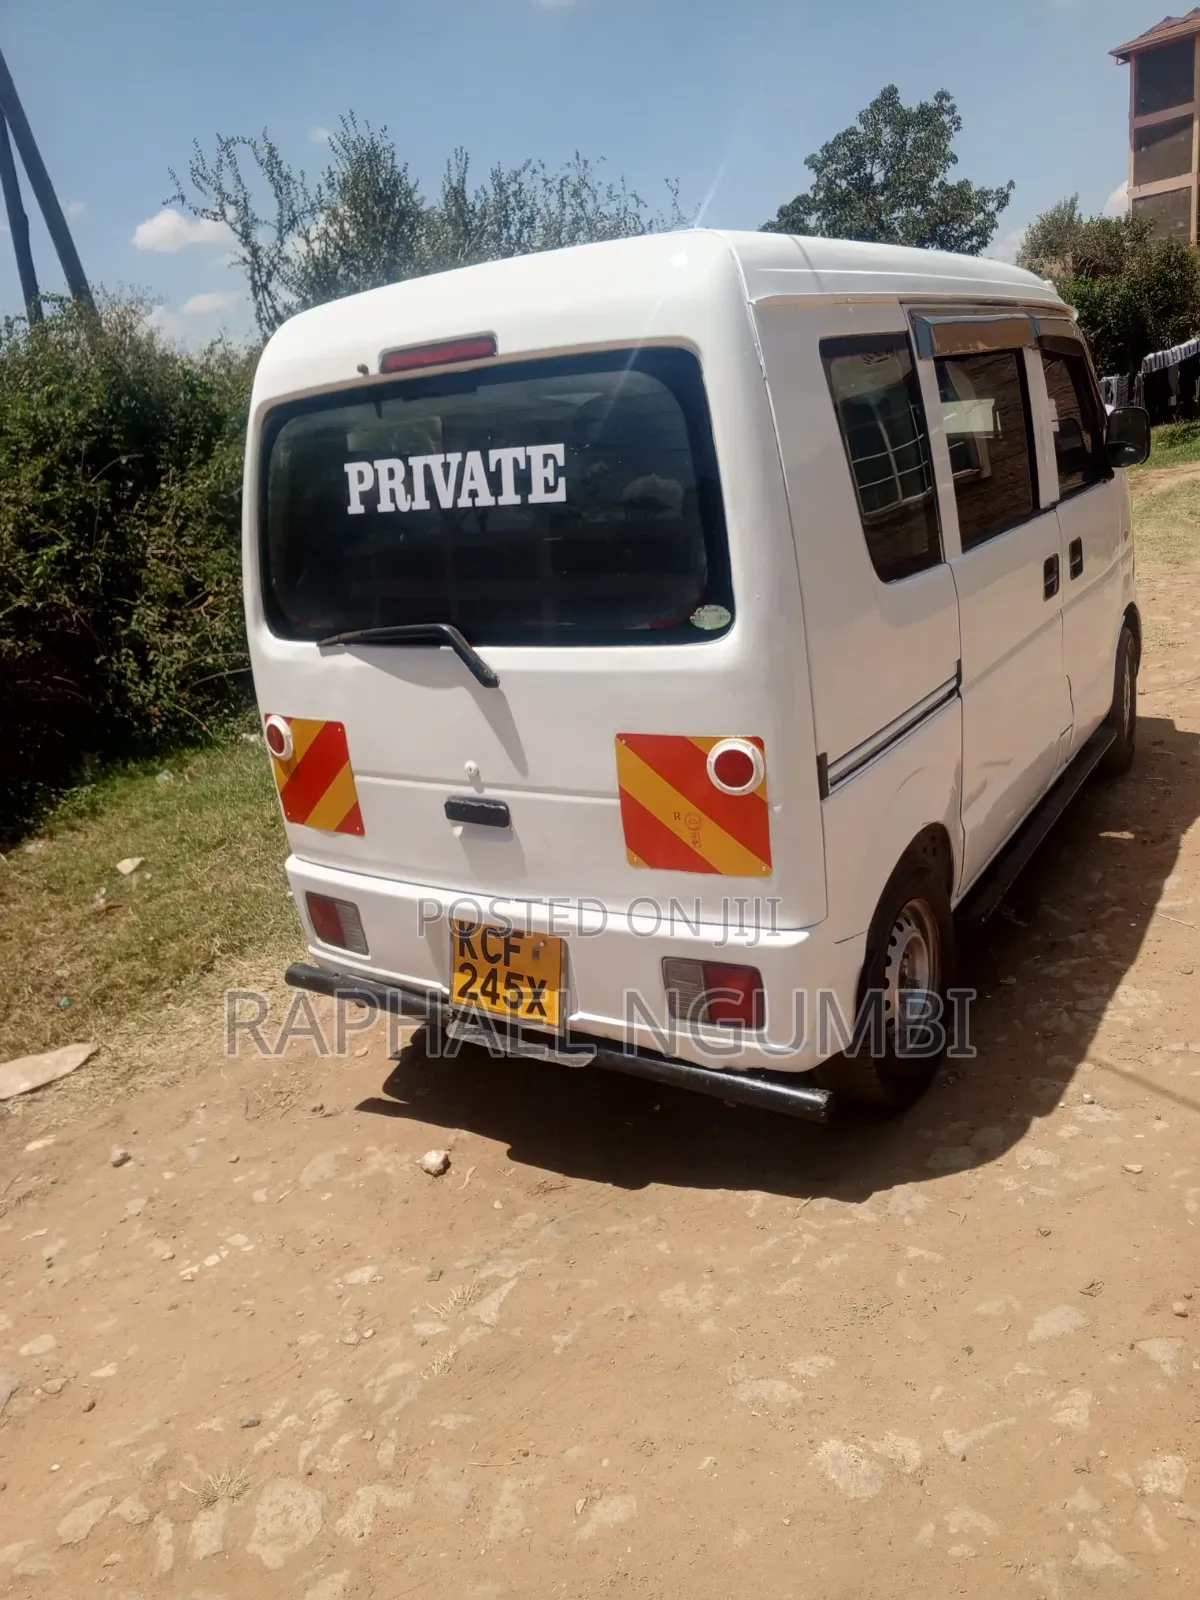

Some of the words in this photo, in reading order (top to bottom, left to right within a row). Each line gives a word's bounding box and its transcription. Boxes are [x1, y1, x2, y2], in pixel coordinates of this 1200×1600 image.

[344, 443, 567, 515] PRIVATE
[458, 920, 525, 967] KCF
[457, 962, 548, 1017] 245X
